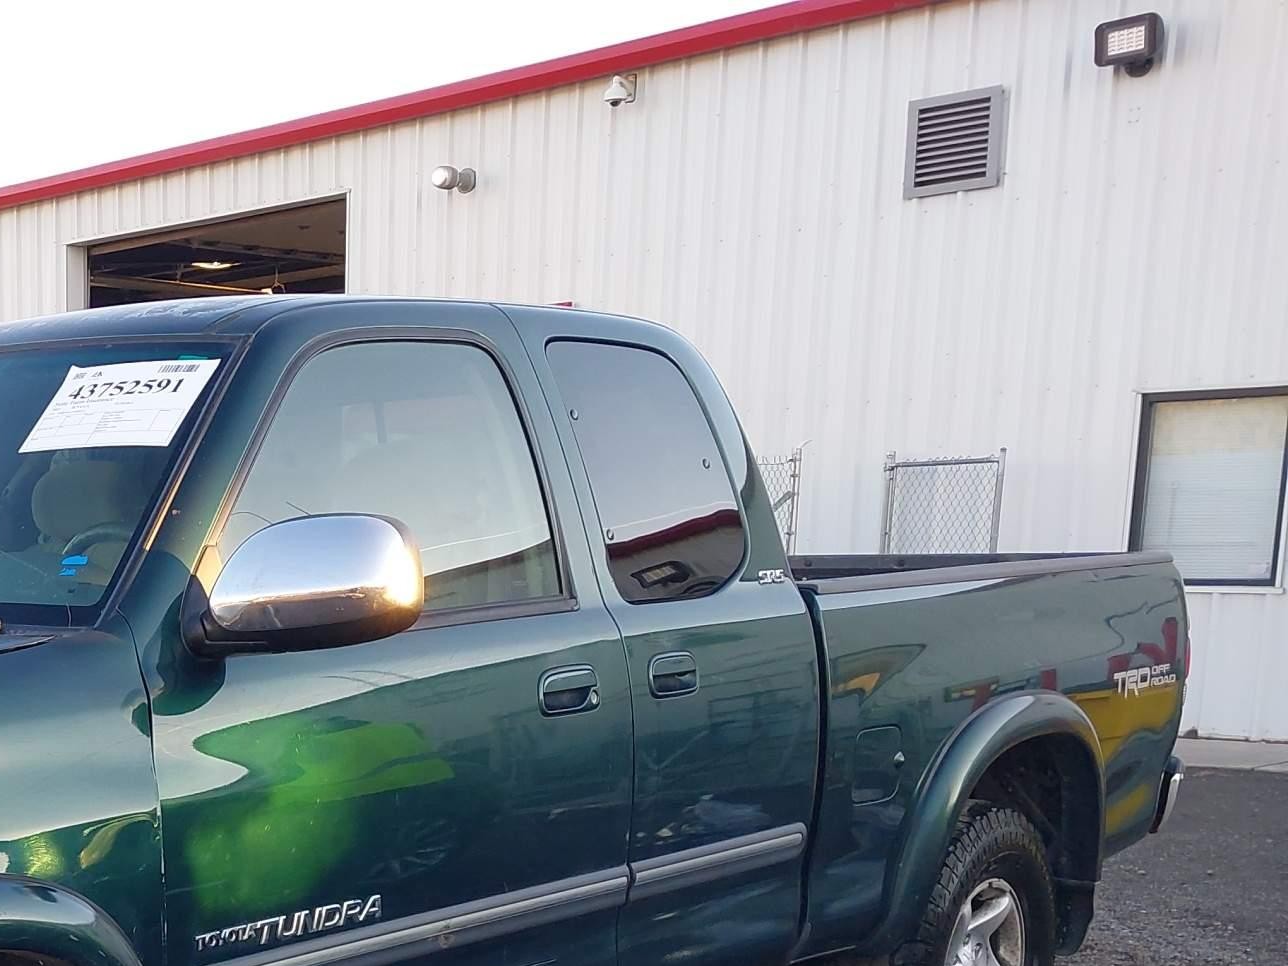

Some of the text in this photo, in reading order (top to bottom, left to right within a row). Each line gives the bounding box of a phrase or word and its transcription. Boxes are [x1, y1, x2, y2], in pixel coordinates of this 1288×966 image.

[68, 378, 186, 400] 43752591
[1151, 663, 1171, 674] OFF
[1113, 667, 1150, 699] TRD
[1150, 674, 1176, 687] ROAD
[194, 894, 382, 951] TOYOTA TUNDRA
